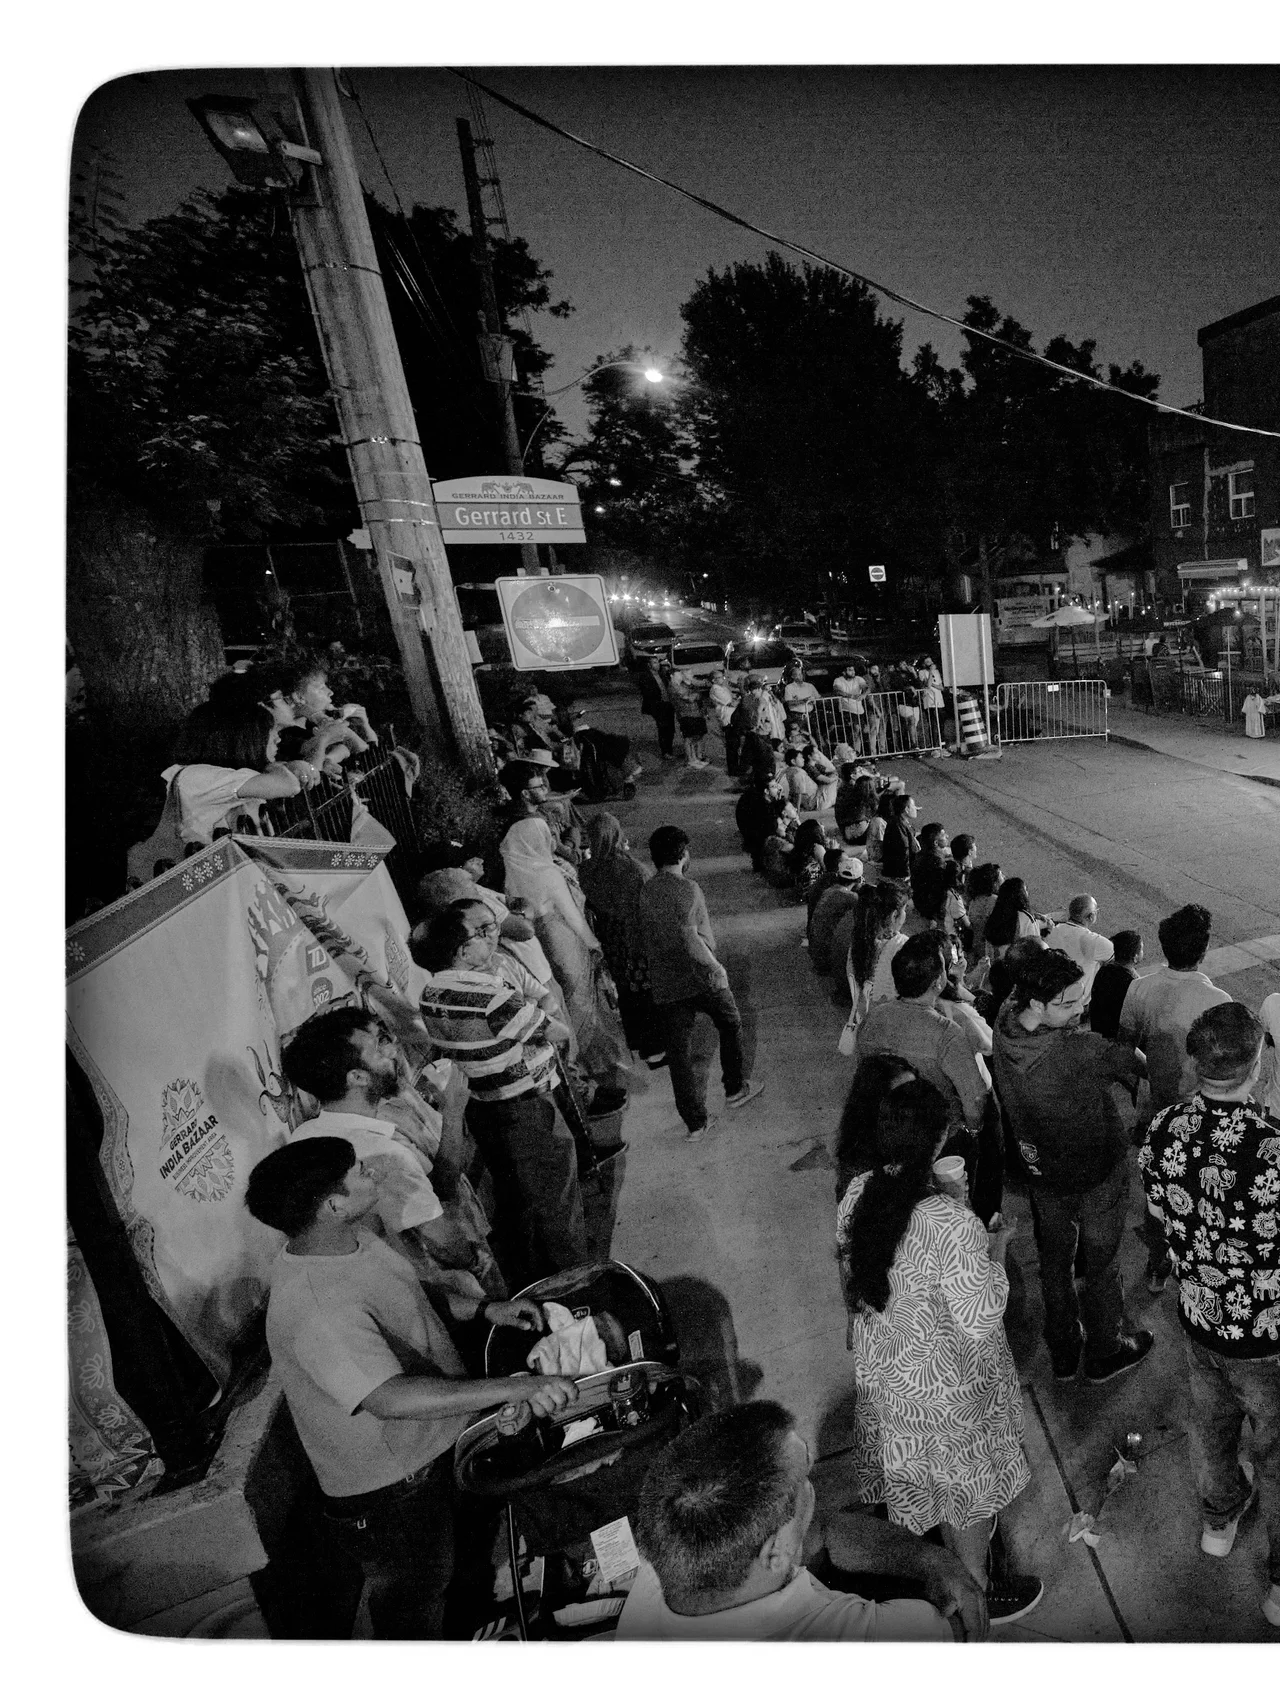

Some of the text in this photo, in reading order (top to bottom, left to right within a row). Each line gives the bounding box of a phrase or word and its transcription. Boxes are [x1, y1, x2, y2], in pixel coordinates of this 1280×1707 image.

[455, 507, 568, 526] Gerrard St E
[499, 531, 534, 541] 1432
[159, 1114, 219, 1180] INDIA BAZAAR
[169, 1118, 198, 1151] GERRAR
